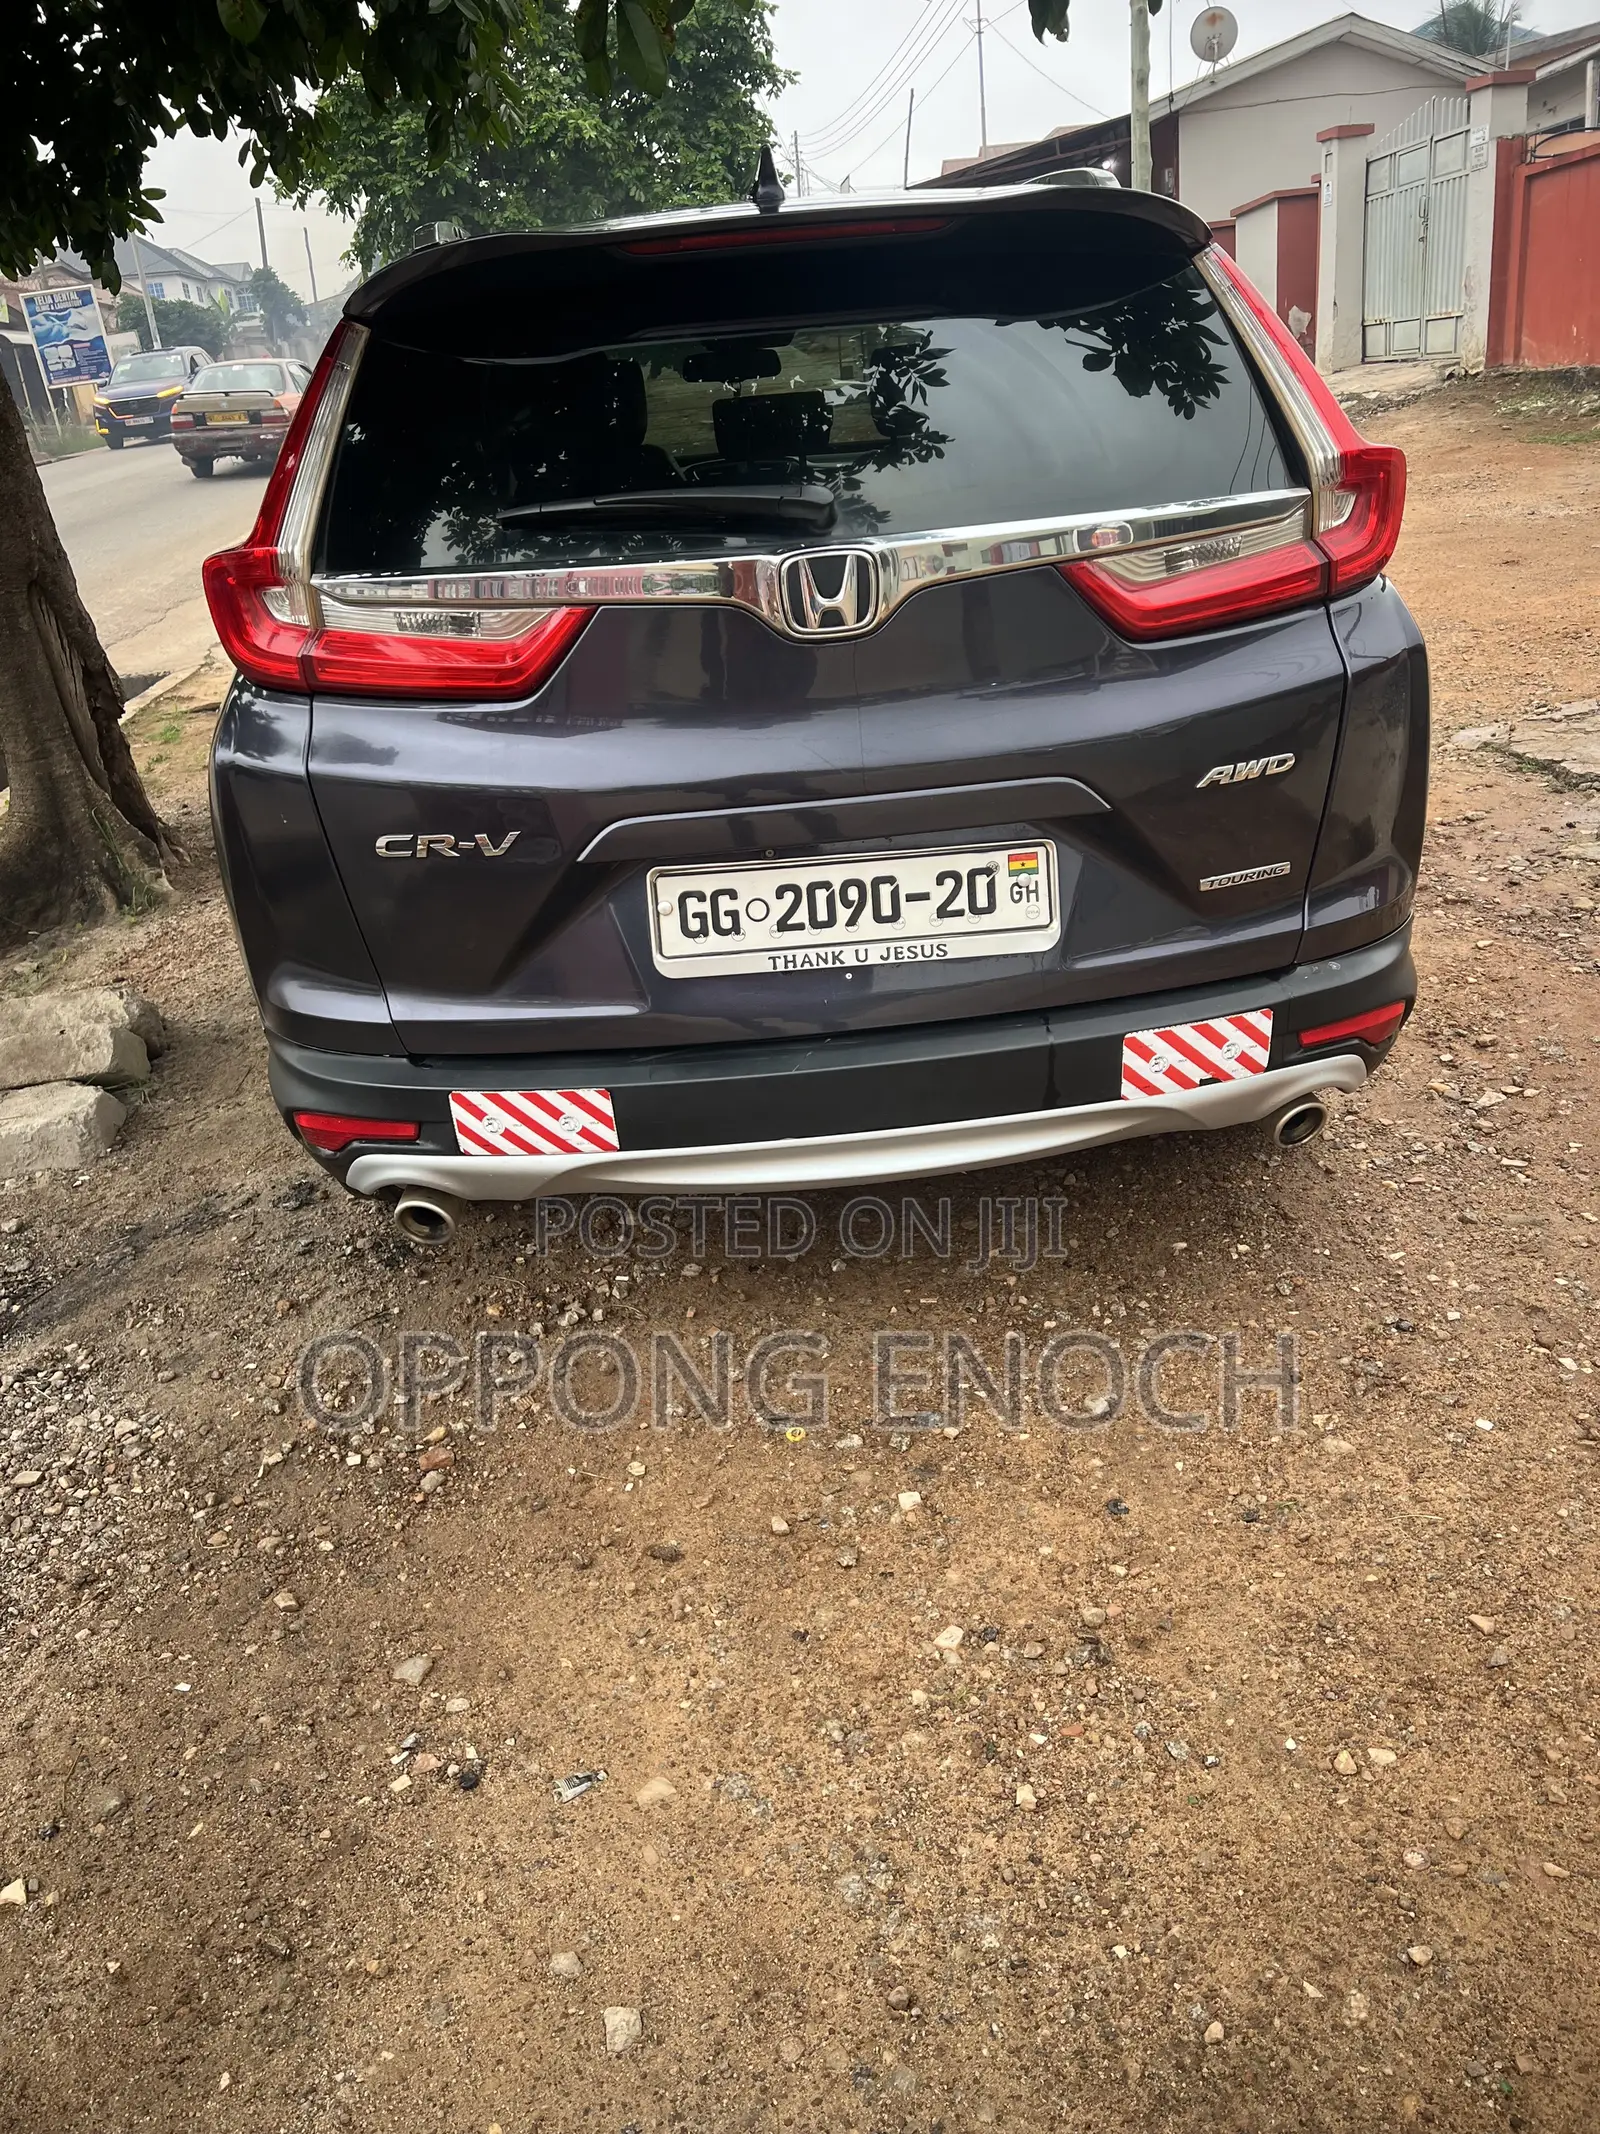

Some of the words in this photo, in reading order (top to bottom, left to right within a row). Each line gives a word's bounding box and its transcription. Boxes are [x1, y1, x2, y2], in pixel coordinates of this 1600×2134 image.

[54, 291, 80, 303] DENTAL
[1196, 753, 1296, 788] AWD
[375, 831, 521, 858] CR-V
[1206, 866, 1287, 889] TOURING
[678, 887, 740, 938] GG
[774, 867, 998, 933] 2090-20
[1010, 880, 1039, 904] GH
[768, 950, 846, 971] THANK
[854, 948, 869, 963] U
[879, 943, 949, 962] JESUS
